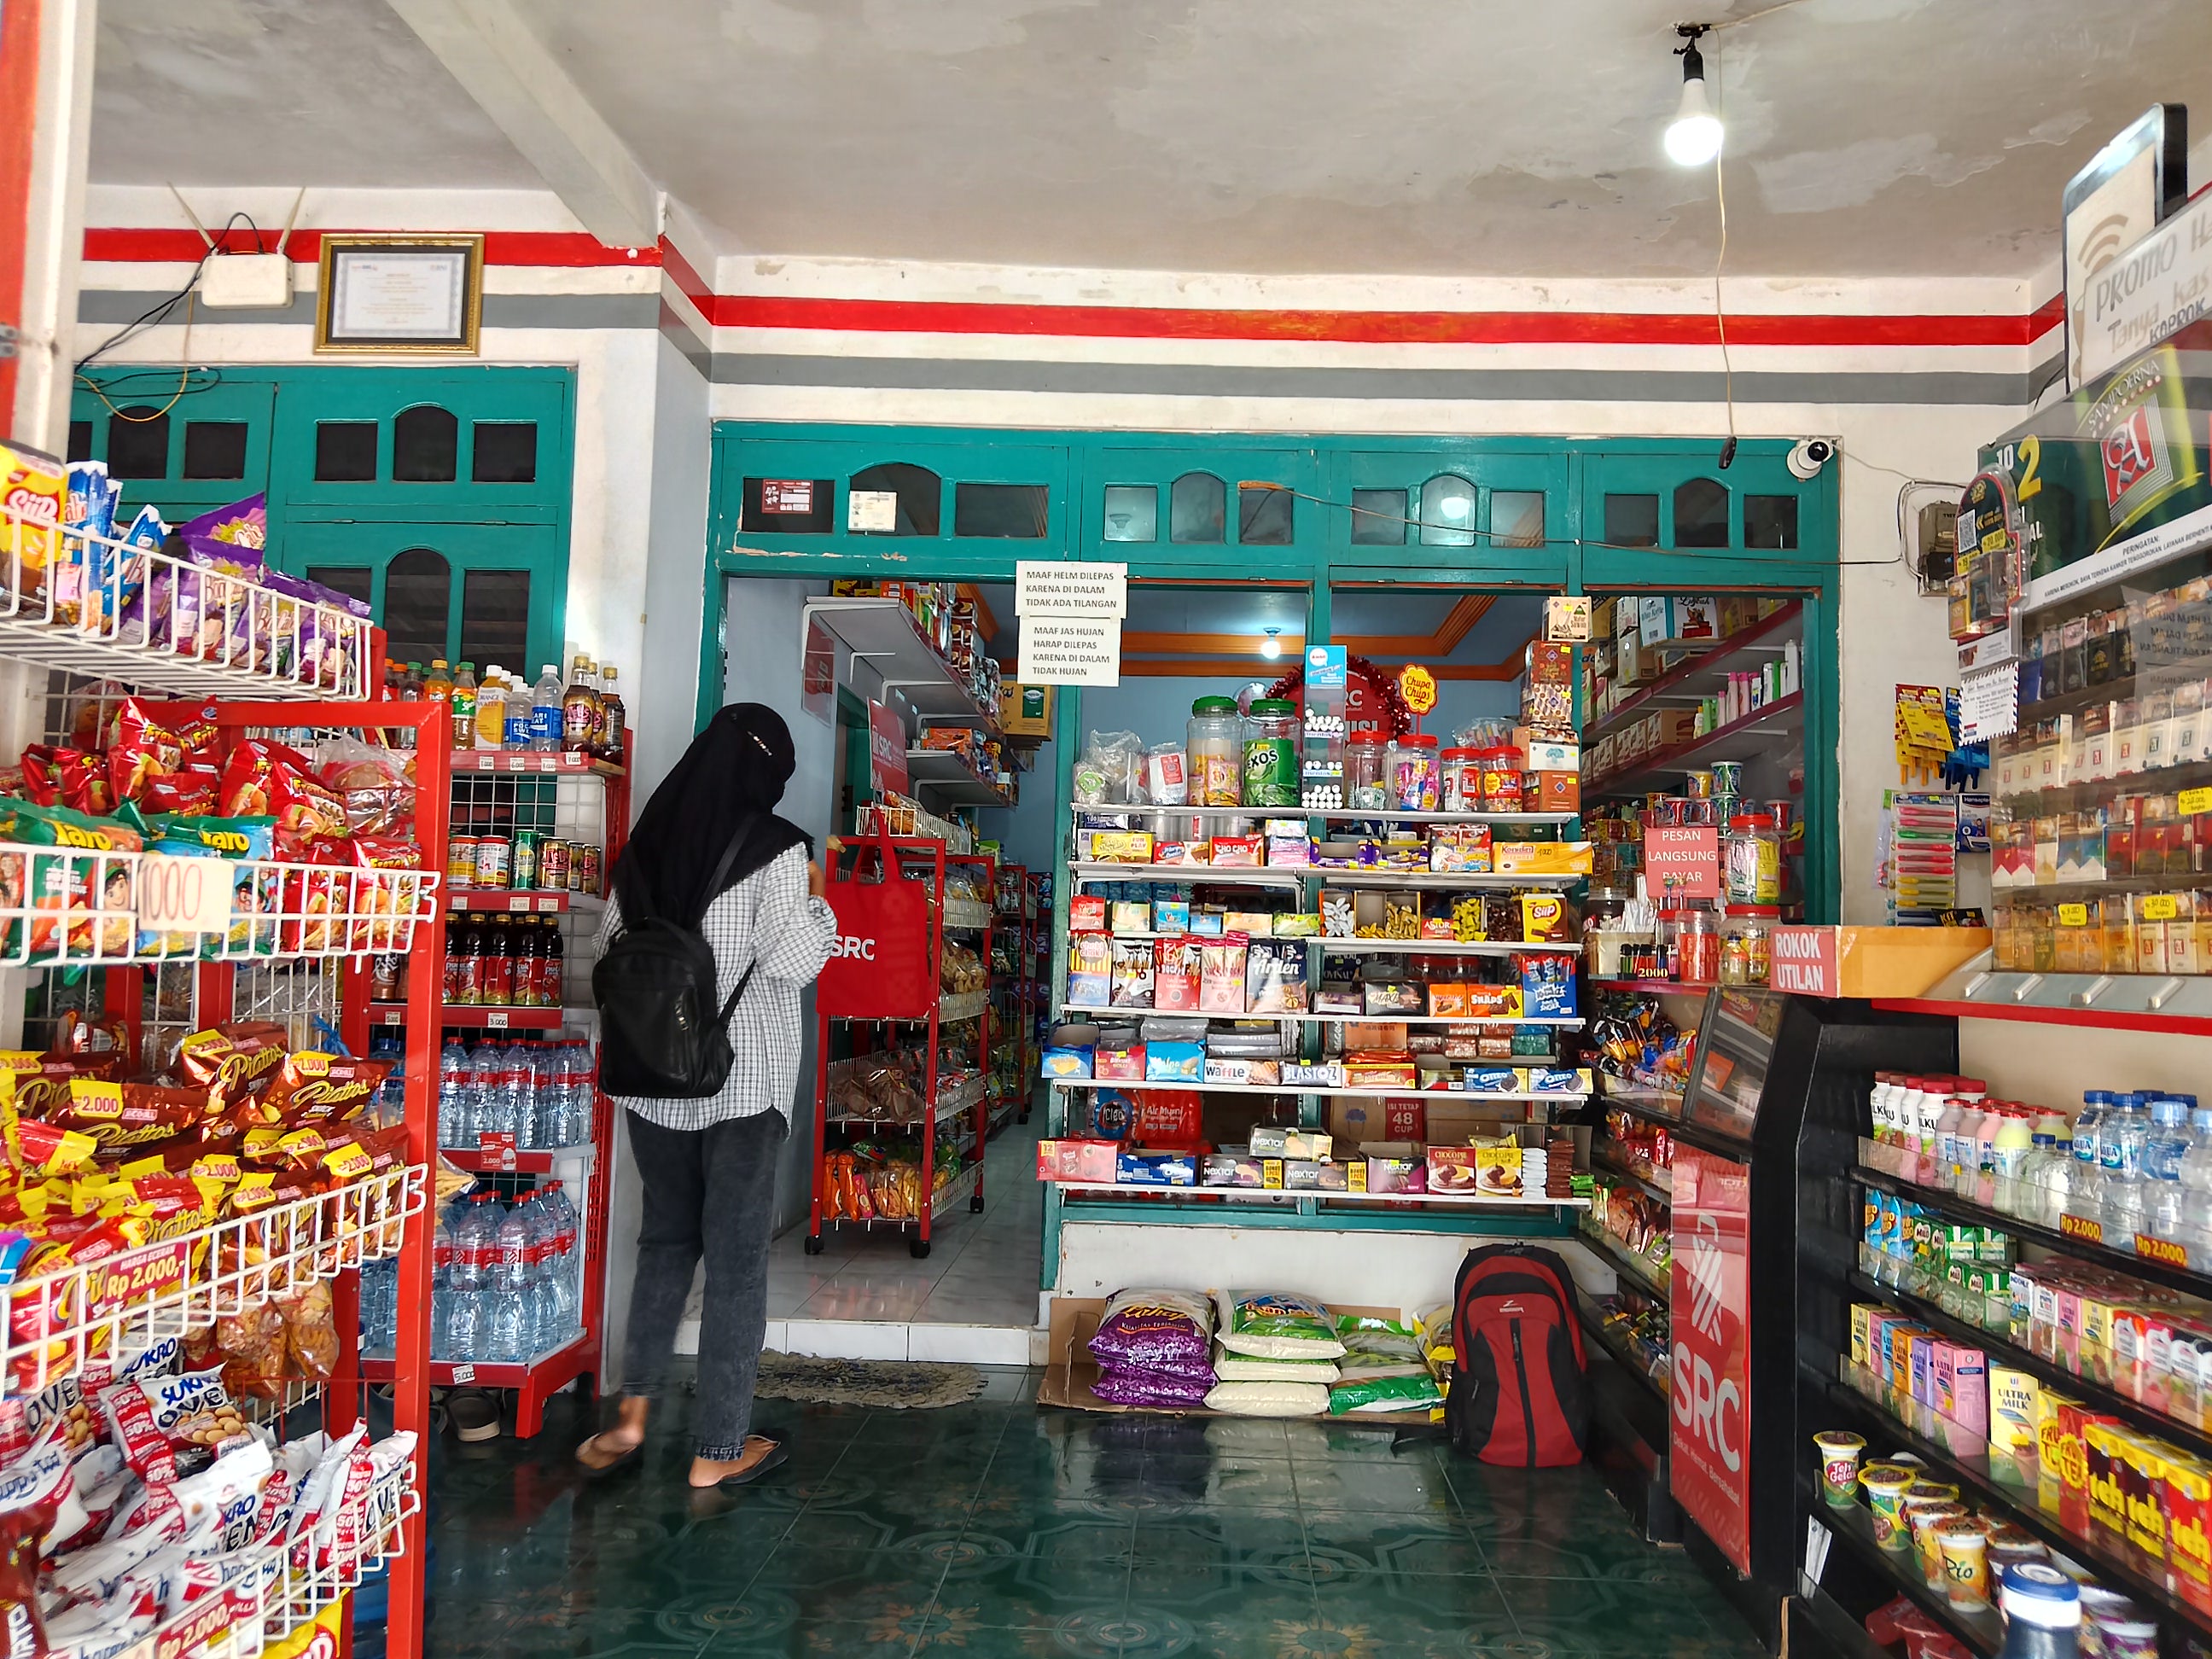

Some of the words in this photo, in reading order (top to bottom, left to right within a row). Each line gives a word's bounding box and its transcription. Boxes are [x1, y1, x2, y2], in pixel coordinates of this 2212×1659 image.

[2097, 232, 2176, 321] PROMO
[2087, 360, 2160, 429] SAMPOERNA
[1064, 641, 1097, 649] DILEPAS
[1033, 654, 1067, 662] KARENA
[1080, 655, 1109, 663] DALAM
[1060, 667, 1087, 676] HUJAN
[1406, 676, 1431, 689] Chupa
[1406, 686, 1430, 704] Chups
[53, 820, 112, 851] Taro
[1662, 830, 1701, 841] PESAN
[1215, 844, 1231, 853] CHO
[1232, 844, 1248, 853] CHO
[1648, 851, 1716, 861] LANGSUNG
[138, 861, 202, 922] 1000
[831, 934, 875, 961] SRC
[1775, 933, 1821, 958] ROKOK
[1639, 968, 1668, 978] 2000
[1777, 964, 1824, 992] UTILAN
[217, 1044, 286, 1091] Piattos
[290, 1080, 371, 1109] Piattos
[81, 1096, 119, 1113] 2.000
[1147, 1106, 1158, 1115] Air
[1104, 1108, 1124, 1121] Cleo
[1392, 1112, 1413, 1125] 48
[76, 1122, 178, 1147] Piattos
[1394, 1125, 1413, 1133] CUP
[1043, 1144, 1053, 1152] 12
[207, 1164, 237, 1177] 2.000
[1203, 1166, 1235, 1176] Nextar
[1287, 1169, 1318, 1179] Nextar
[2061, 1215, 2075, 1231] Rp
[2136, 1237, 2151, 1254] Rp
[120, 1253, 147, 1271] HARGA
[106, 1274, 128, 1299] Rp
[131, 1254, 186, 1289] 2.000,-
[1998, 1388, 2032, 1401] ULTRA
[1674, 1342, 1740, 1472] SRC
[2001, 1397, 2029, 1411] MILK
[1833, 1462, 1851, 1474] Teh
[1830, 1470, 1856, 1482] Gelas
